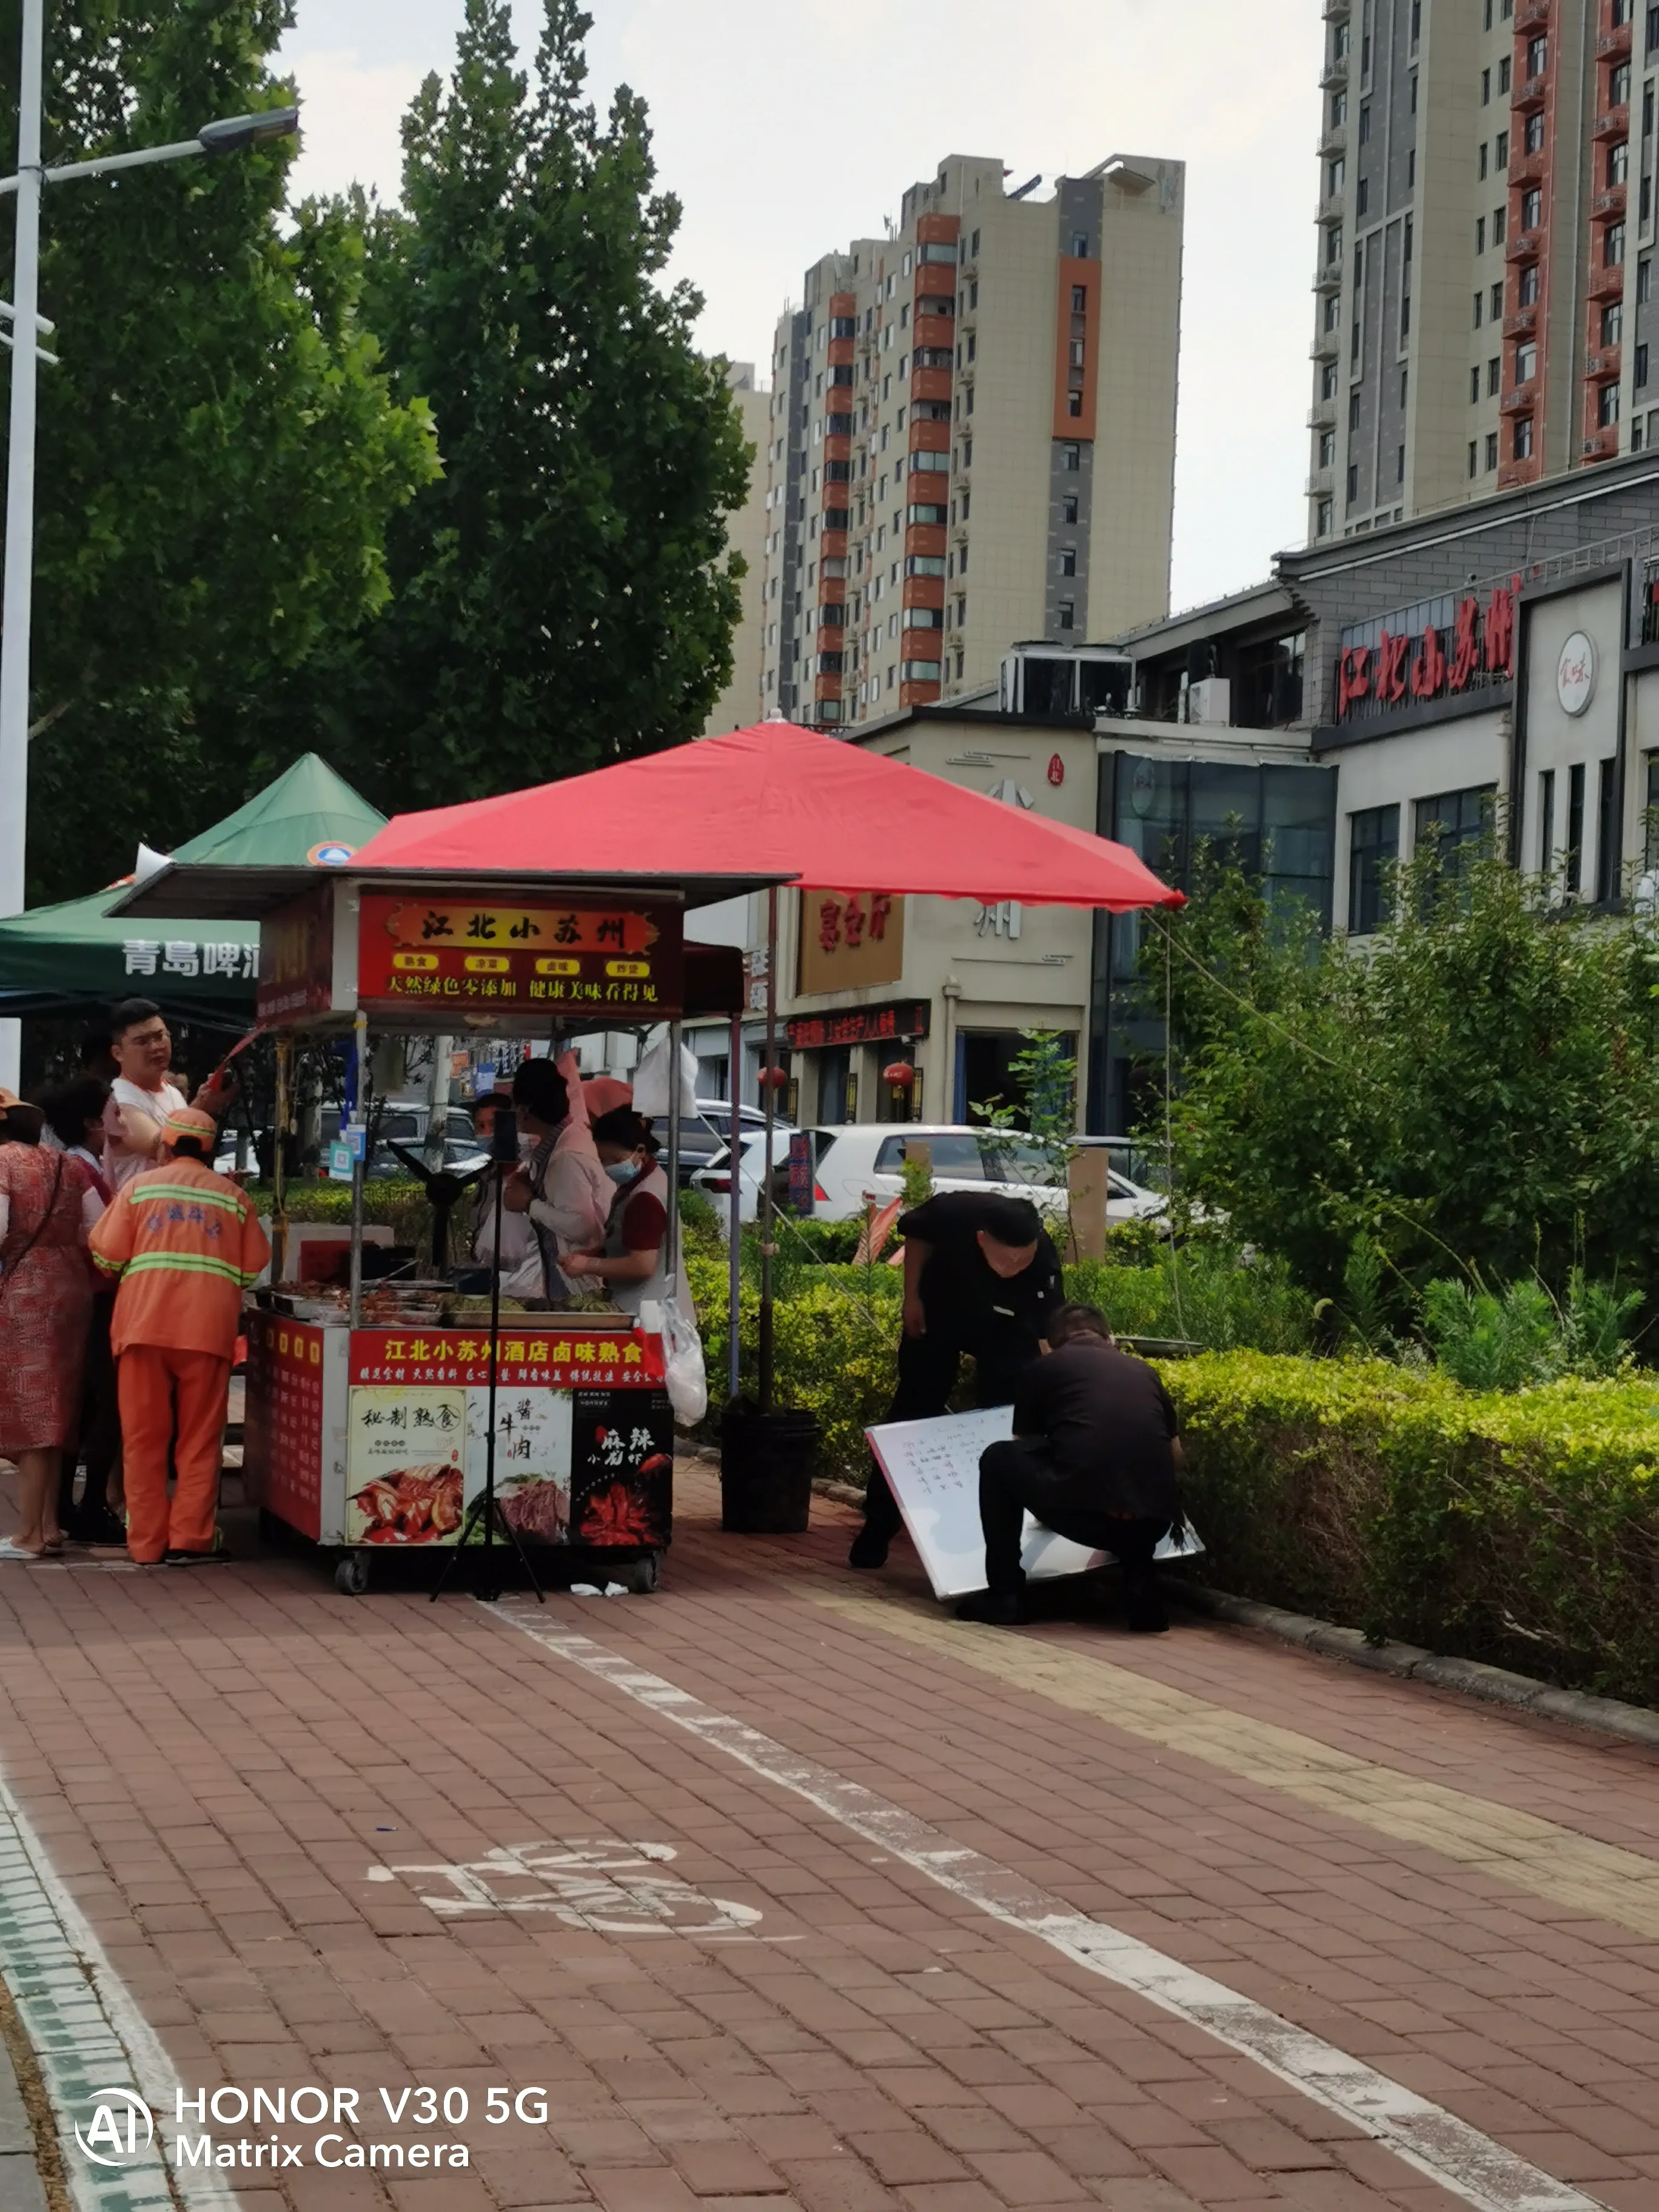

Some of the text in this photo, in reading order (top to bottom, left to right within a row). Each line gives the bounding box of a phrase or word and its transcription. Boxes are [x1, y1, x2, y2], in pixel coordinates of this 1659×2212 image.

[1339, 574, 1521, 716] 江北小苏州
[421, 910, 627, 949] 江北小苏州
[361, 1404, 461, 1432] 秘制熟食
[602, 1427, 655, 1452] 麻辣
